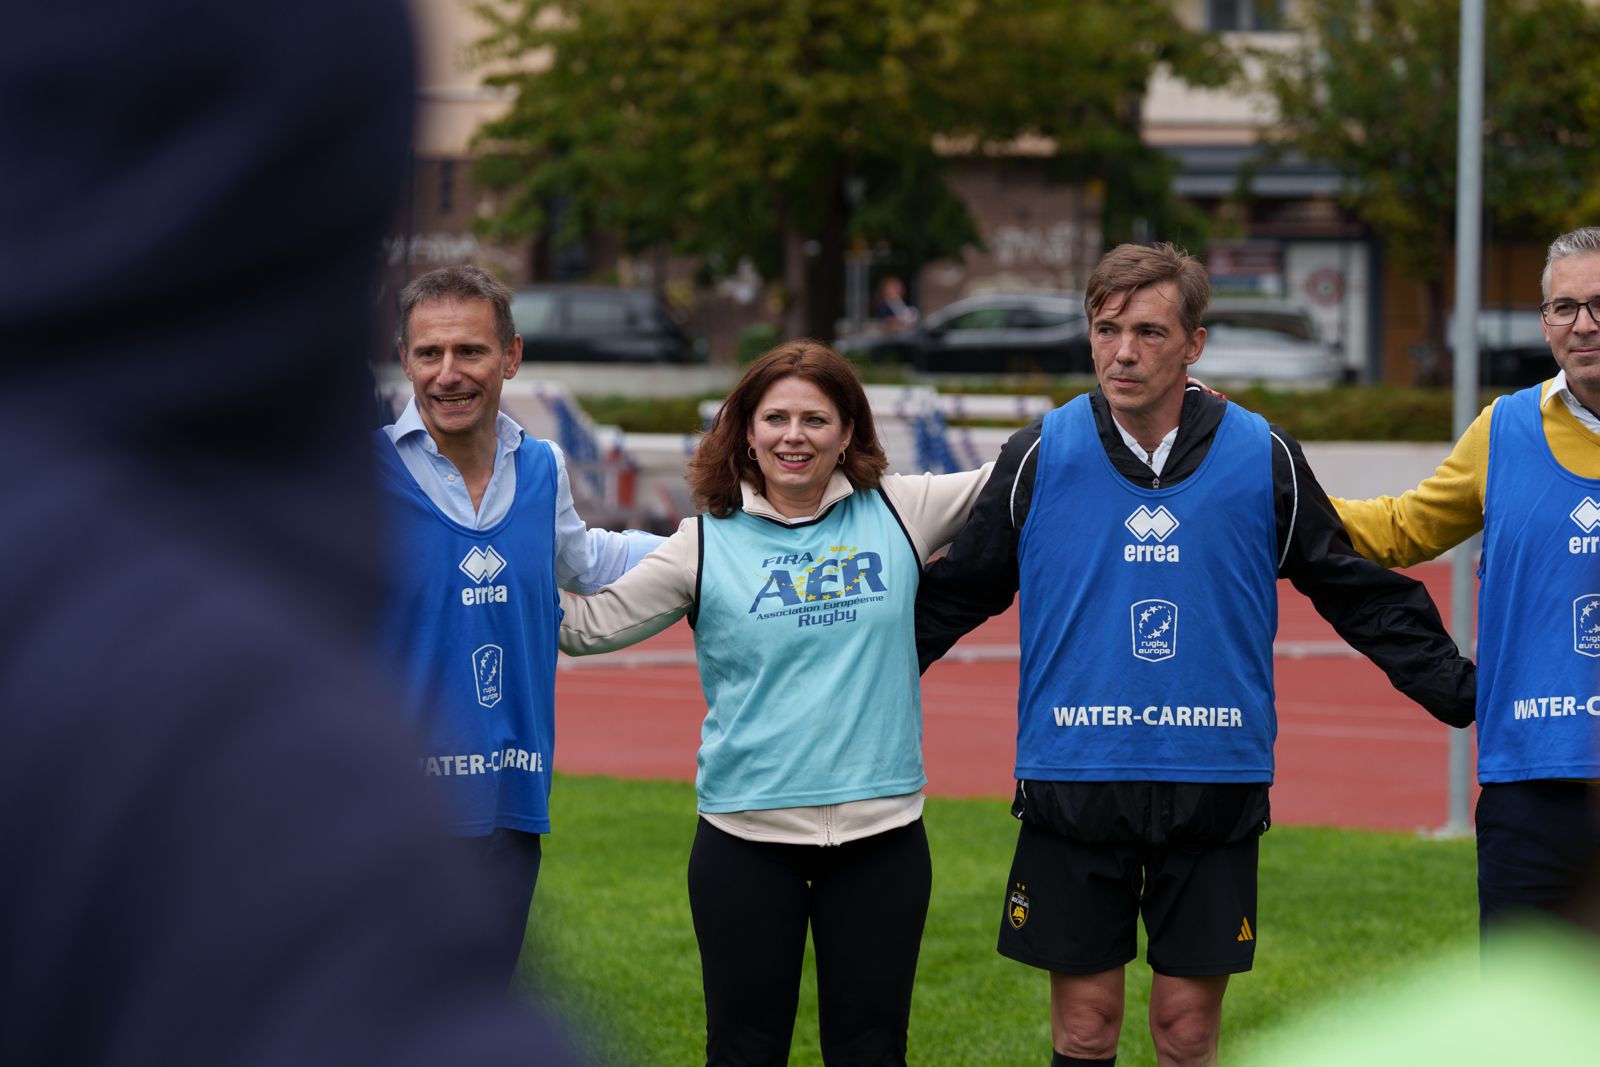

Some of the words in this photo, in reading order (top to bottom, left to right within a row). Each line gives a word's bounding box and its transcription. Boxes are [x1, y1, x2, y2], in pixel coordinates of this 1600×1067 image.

[762, 552, 814, 568] FIRA
[1124, 544, 1180, 563] errea
[748, 551, 888, 614] AER
[461, 585, 508, 606] errea
[756, 604, 820, 621] Association
[823, 595, 884, 610] Européenne
[798, 609, 857, 627] Rugby
[1141, 640, 1168, 648] rugby
[1053, 705, 1243, 728] WATER-CARRIER
